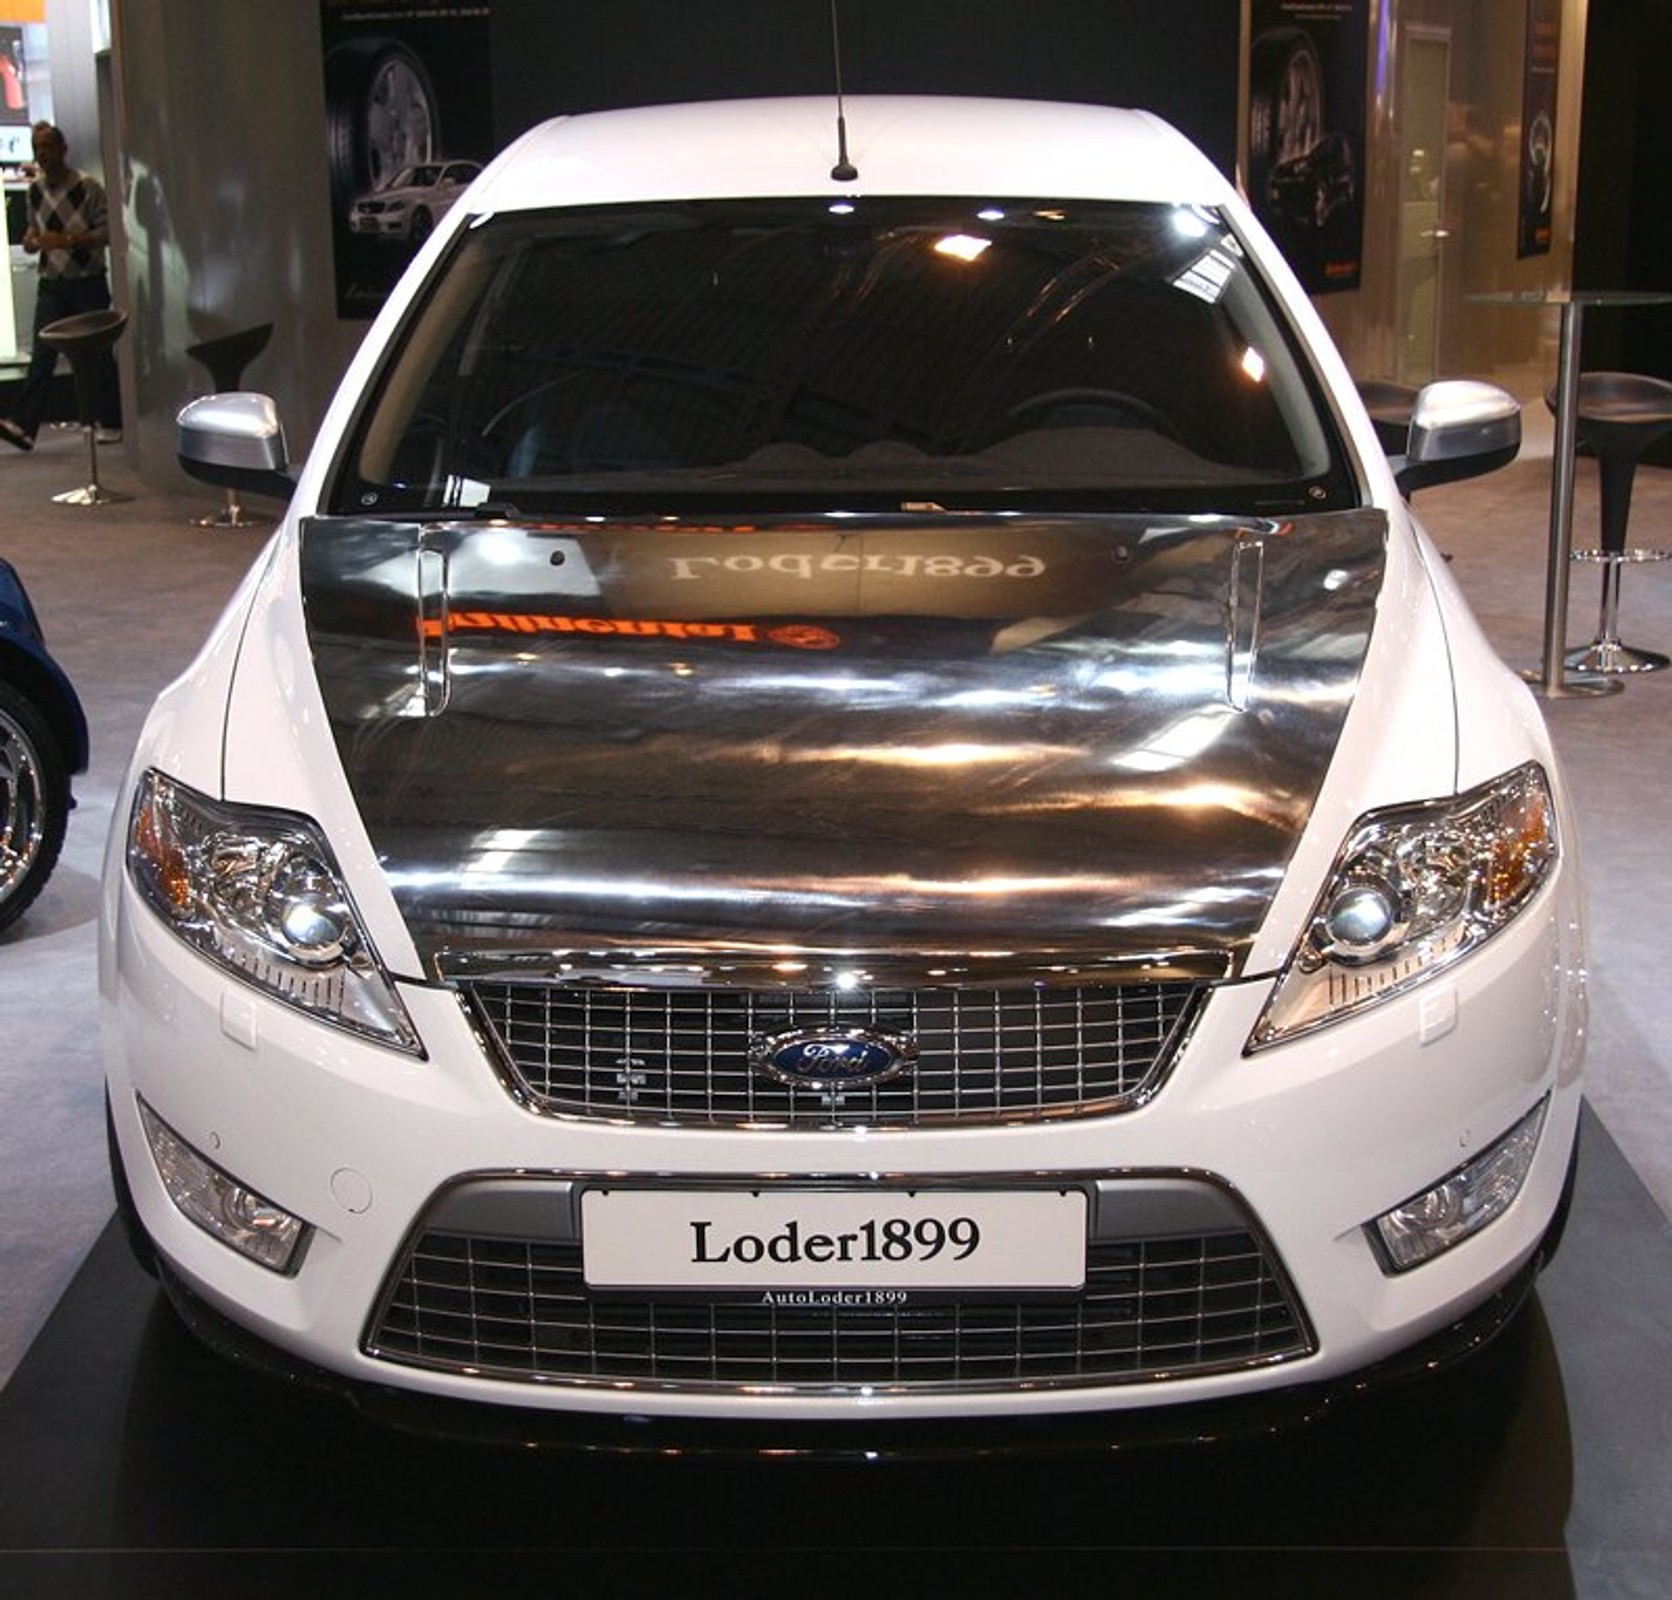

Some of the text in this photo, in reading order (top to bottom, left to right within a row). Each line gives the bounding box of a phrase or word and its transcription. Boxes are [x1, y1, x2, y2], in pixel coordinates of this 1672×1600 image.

[797, 1043, 869, 1073] Ford
[689, 1217, 981, 1264] Loder1899
[761, 1291, 908, 1305] AutoLoder1899
